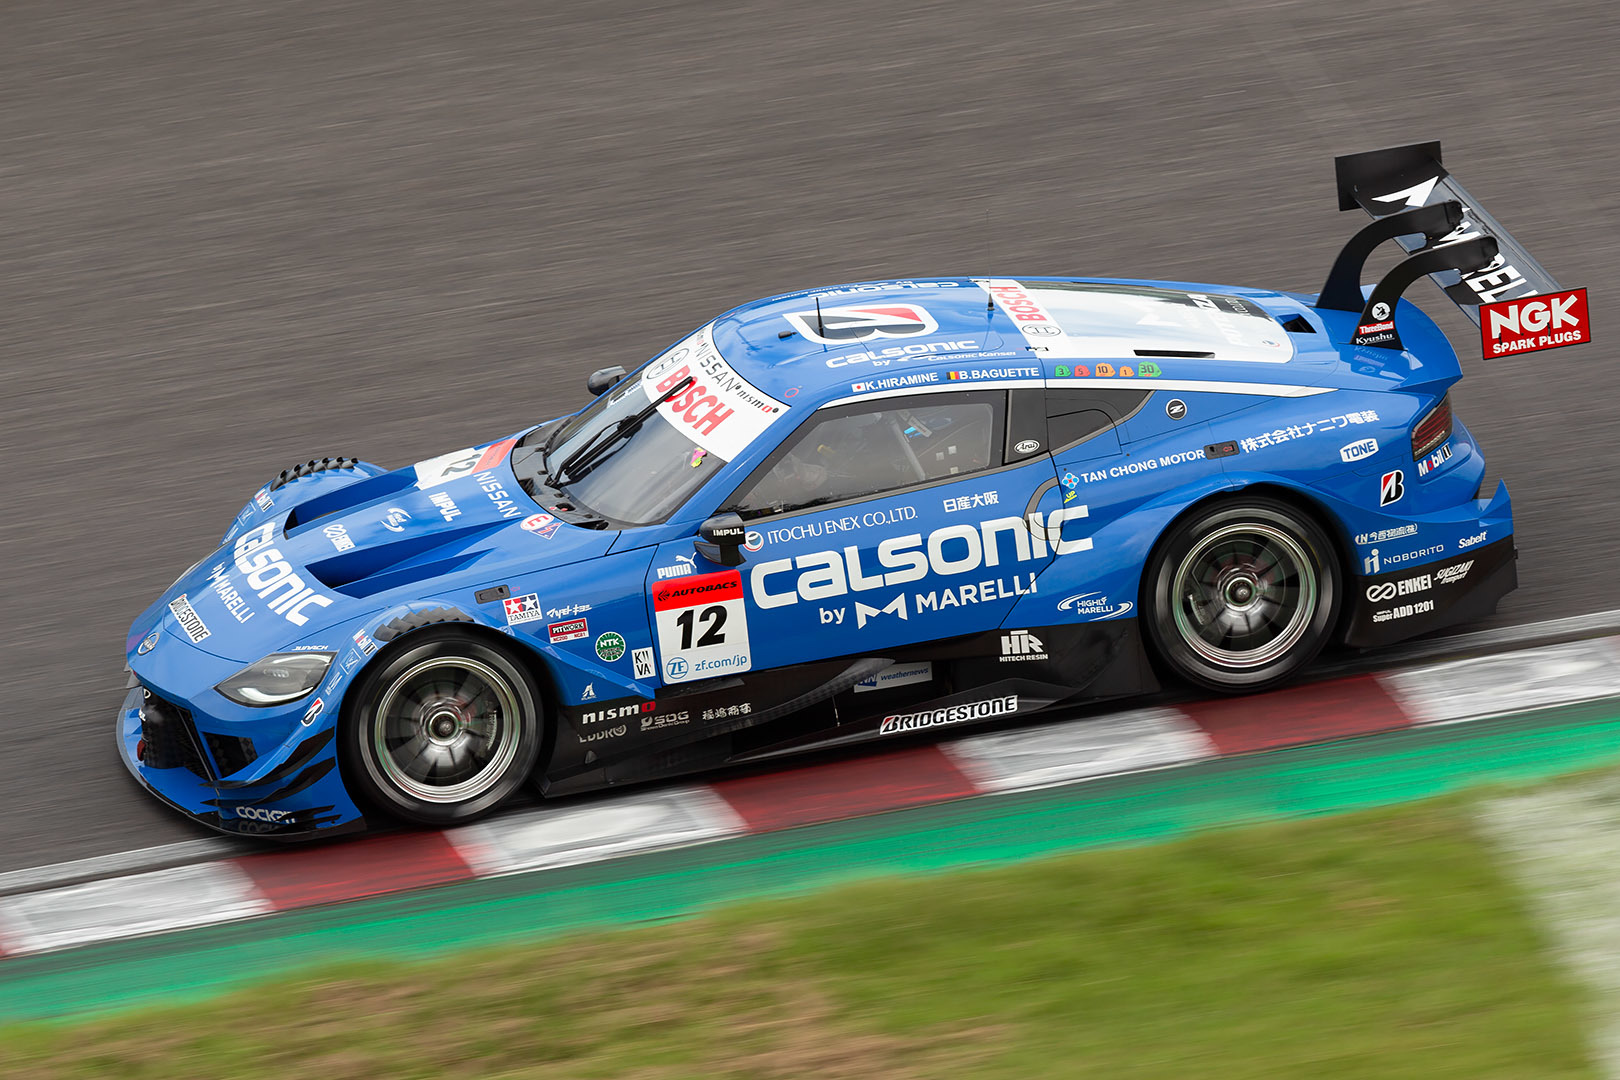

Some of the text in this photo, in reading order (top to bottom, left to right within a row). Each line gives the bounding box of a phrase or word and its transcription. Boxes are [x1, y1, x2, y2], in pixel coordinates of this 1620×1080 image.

[989, 287, 1047, 321] BOSCH
[1489, 294, 1580, 340] NGK
[1359, 321, 1394, 334] ThreeBond
[1356, 333, 1393, 345] Kyushu
[1493, 330, 1582, 354] SPARK PLUGS
[694, 343, 739, 392] NISSAN
[959, 367, 1040, 380] B.BAGUETTE
[1097, 366, 1108, 374] 10
[1140, 364, 1155, 373] 30
[865, 372, 939, 390] K.HIRAMINE
[656, 365, 735, 436] BOSCH
[1240, 410, 1380, 453] 株式会社ナニワ電装
[1343, 441, 1375, 459] TONE
[1081, 449, 1205, 483] TAN CHONG MOTOR
[1418, 449, 1444, 477] Mobil
[473, 471, 521, 518] NISSAN
[943, 491, 999, 513] 日産大阪
[428, 492, 462, 522] IMPUL
[713, 528, 744, 537] IMPUL
[767, 522, 823, 545] ITOCHU
[825, 515, 859, 534] ENEX
[1458, 531, 1487, 548] Sabelt
[1383, 544, 1444, 565] NOBORITO
[657, 564, 692, 579] PUMA
[672, 581, 737, 597] AUTOBACS
[1397, 574, 1432, 596] ENKEI
[819, 607, 846, 626] by
[915, 572, 1039, 614] MARELLI
[1077, 596, 1107, 607] HIGHLY
[508, 610, 540, 621] TAMIYA
[1077, 605, 1113, 614] MARELLI
[1393, 604, 1413, 619] ADD
[1414, 600, 1434, 615] 1201
[552, 622, 584, 634] PITWORK
[676, 605, 728, 650] 12
[600, 638, 620, 648] NTK
[668, 654, 748, 676] ZF zf.com/jp
[1026, 653, 1048, 661] RESIN
[881, 667, 928, 680] weathernews
[582, 701, 656, 724] nismo
[881, 696, 1017, 734] BRIDGESTONE
[236, 806, 296, 823] COCKP
